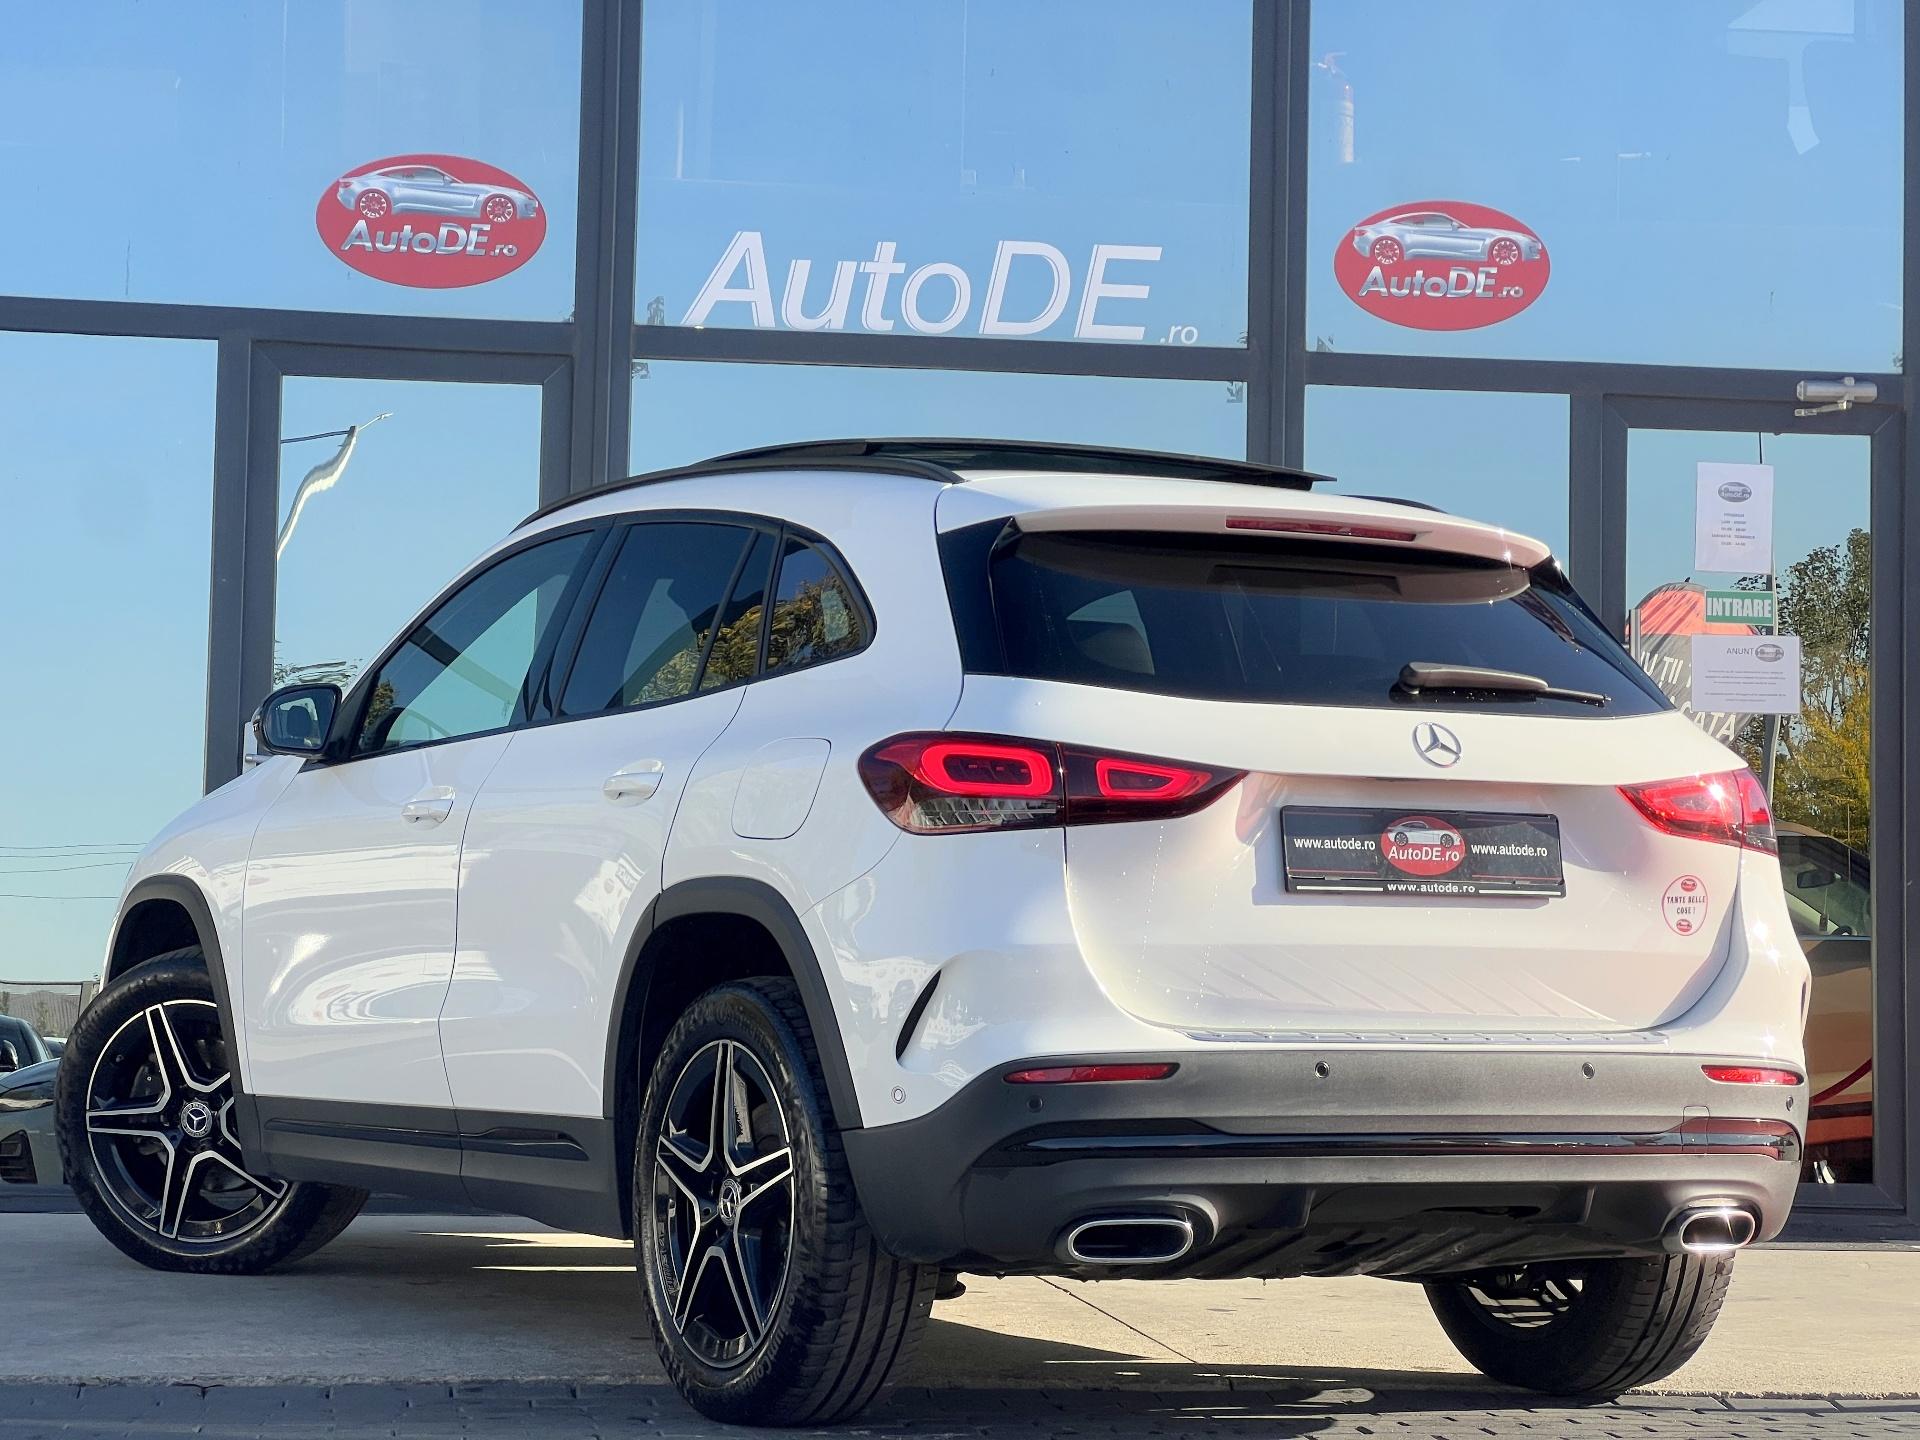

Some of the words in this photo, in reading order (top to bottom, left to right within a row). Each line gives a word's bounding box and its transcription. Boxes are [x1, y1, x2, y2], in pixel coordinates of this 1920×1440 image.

[1706, 597, 1772, 618] INTRARE
[1294, 837, 1376, 851] www.autode.ro
[1471, 843, 1548, 857] www.autode.ro
[1388, 845, 1460, 862] AutoDE.ro
[1387, 883, 1476, 894] www.autode.ro
